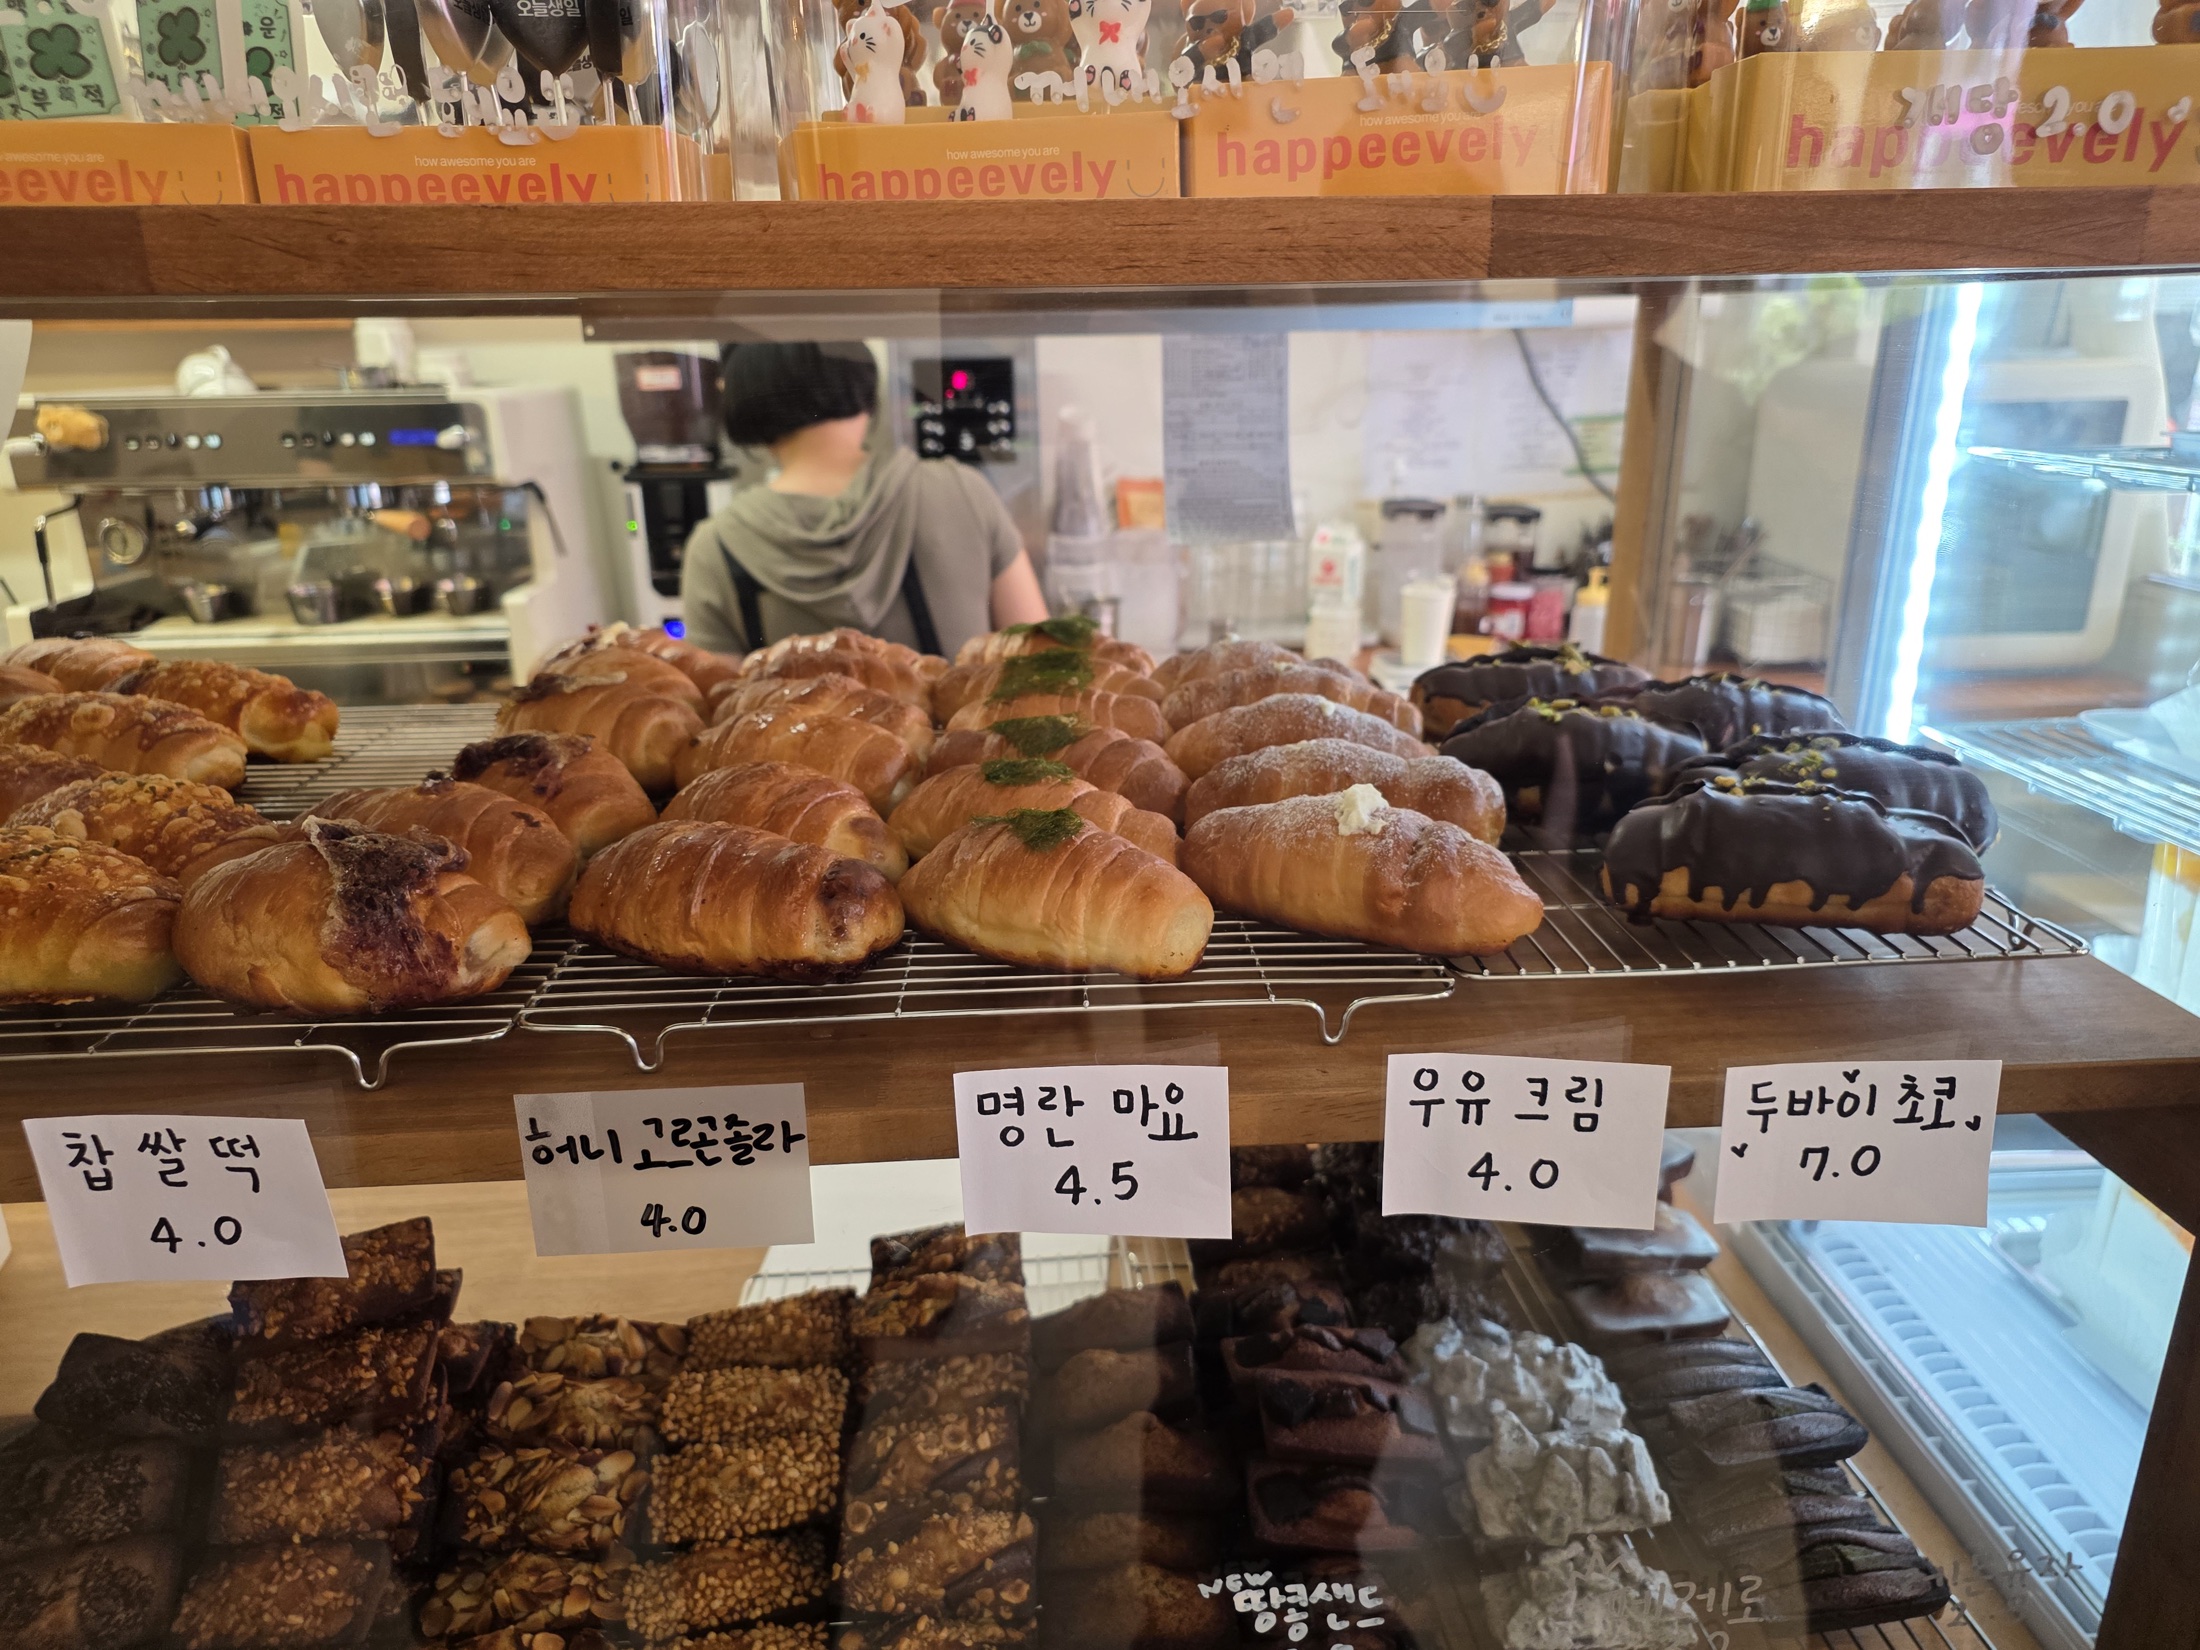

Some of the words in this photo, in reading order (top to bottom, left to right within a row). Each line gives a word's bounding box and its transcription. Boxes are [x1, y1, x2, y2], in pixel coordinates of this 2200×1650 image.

[517, 0, 582, 18] 오늘생일
[1359, 115, 1383, 127] how
[1384, 113, 1440, 126] awesome
[1440, 112, 1462, 127] you
[2034, 84, 2137, 139] 2.0
[414, 155, 438, 167] how
[439, 157, 496, 168] awesome
[496, 157, 516, 170] you
[517, 157, 536, 167] are
[946, 147, 973, 160] how
[974, 147, 1020, 160] awesome
[1021, 146, 1041, 159] you
[1042, 145, 1060, 156] are
[1216, 115, 1539, 182] happeevely
[275, 162, 600, 204] happeevely
[818, 151, 1118, 200] happeevely
[976, 1085, 1085, 1148] 명란
[1112, 1082, 1199, 1142] 마요
[1409, 1068, 1491, 1128] 우유
[1514, 1076, 1604, 1133] 크림
[1747, 1082, 1878, 1134] 두바이
[1892, 1074, 1957, 1131] 초코
[525, 1116, 623, 1166] 허니
[632, 1113, 806, 1171] 고르곤졸라
[1054, 1160, 1139, 1206] 4.5
[1467, 1152, 1560, 1192] 4.0
[1799, 1145, 1881, 1182] 7.0
[150, 1215, 242, 1254] 4.0
[640, 1203, 707, 1239] 4.0
[1197, 1570, 1273, 1599] NEW
[1232, 1581, 1386, 1642] 땅콩샌드
